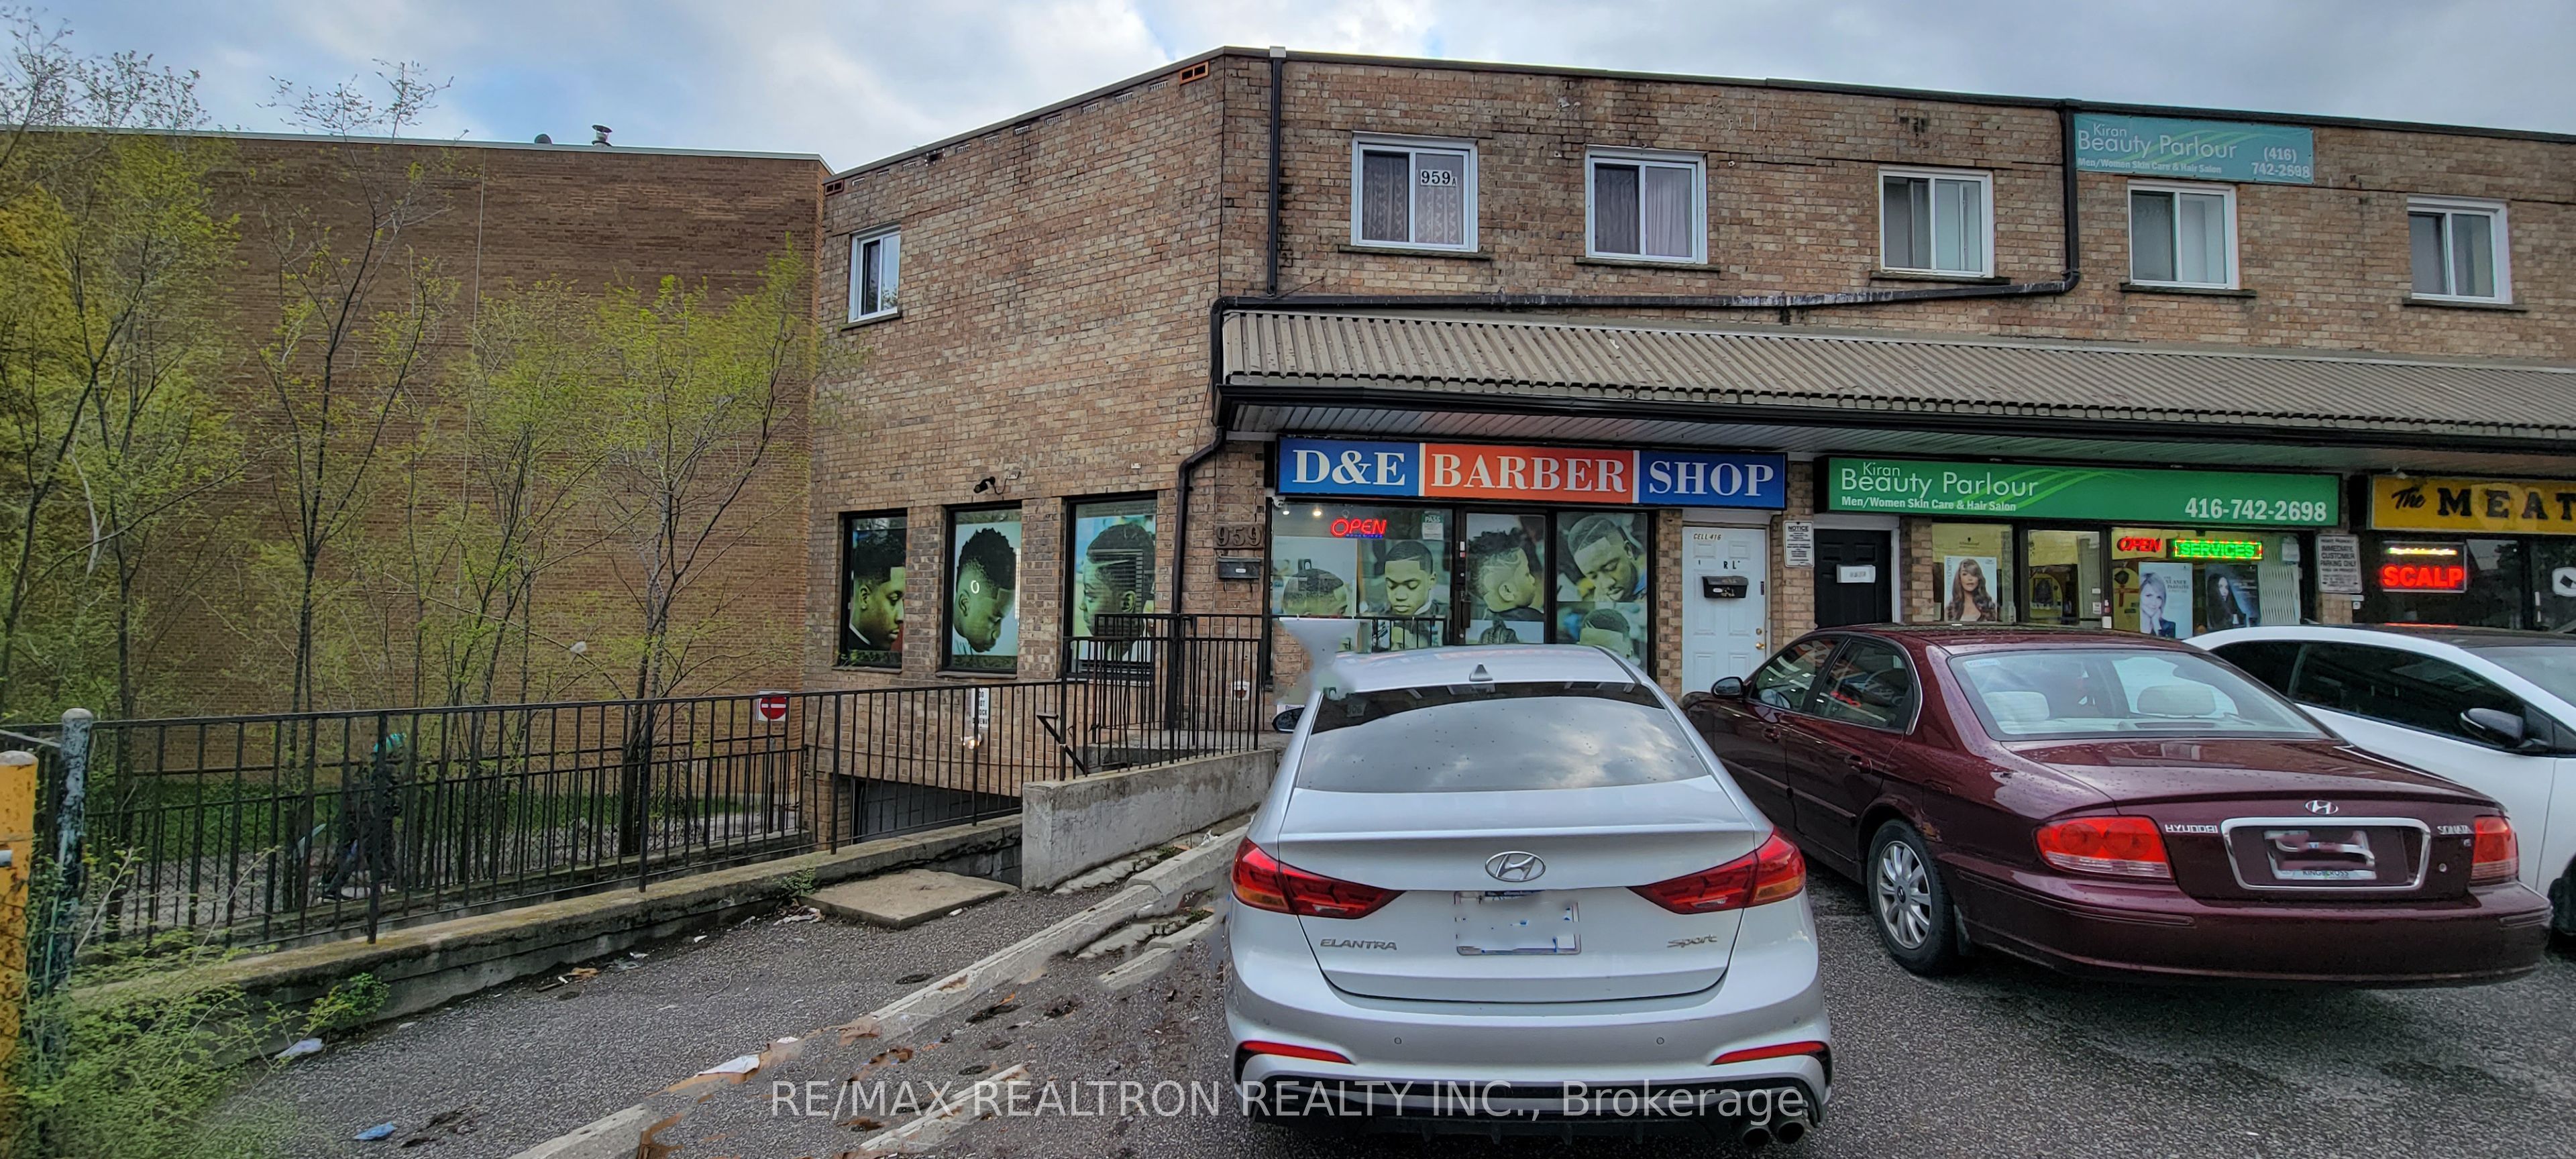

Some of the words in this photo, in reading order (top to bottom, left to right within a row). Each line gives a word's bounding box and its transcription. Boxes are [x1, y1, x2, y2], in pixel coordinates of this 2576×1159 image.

[2093, 123, 2127, 137] Kiran
[2078, 130, 2151, 158] Beauty
[2159, 135, 2237, 158] Parlour
[2264, 147, 2296, 163] (416)
[2078, 158, 2131, 169] Men/Women
[2133, 160, 2149, 169] Skin
[2152, 162, 2171, 170] Care
[2181, 164, 2198, 172] Hair
[2200, 165, 2222, 174] Salon
[2252, 162, 2310, 178] 742-2698
[1292, 449, 1405, 486] D&E
[1431, 454, 1627, 492] BARBER
[1650, 461, 1774, 496] SHOP
[1863, 461, 1900, 476] Kiran
[1841, 468, 1932, 498] Beauty
[1943, 472, 2039, 496] Parlour
[1841, 496, 1906, 508] Men/Women
[1907, 498, 1929, 508] Skin
[1931, 499, 1954, 509] Care
[1956, 500, 1964, 510] &
[1967, 500, 1986, 510] Hair
[1989, 501, 2017, 511] Salon
[2185, 498, 2327, 522] 416-742-2698
[2392, 487, 2426, 509] The
[2437, 488, 2576, 520] MEAT
[1330, 518, 1387, 537] OPEN
[1217, 527, 1261, 546] 959
[2117, 537, 2162, 552] OPEN
[2180, 542, 2255, 557] SERVICES
[2382, 565, 2465, 588] SCALP
[2165, 824, 2218, 833] HYUNDAI
[1320, 939, 1397, 950] ELANTRA
[1667, 934, 1717, 948] Sport
